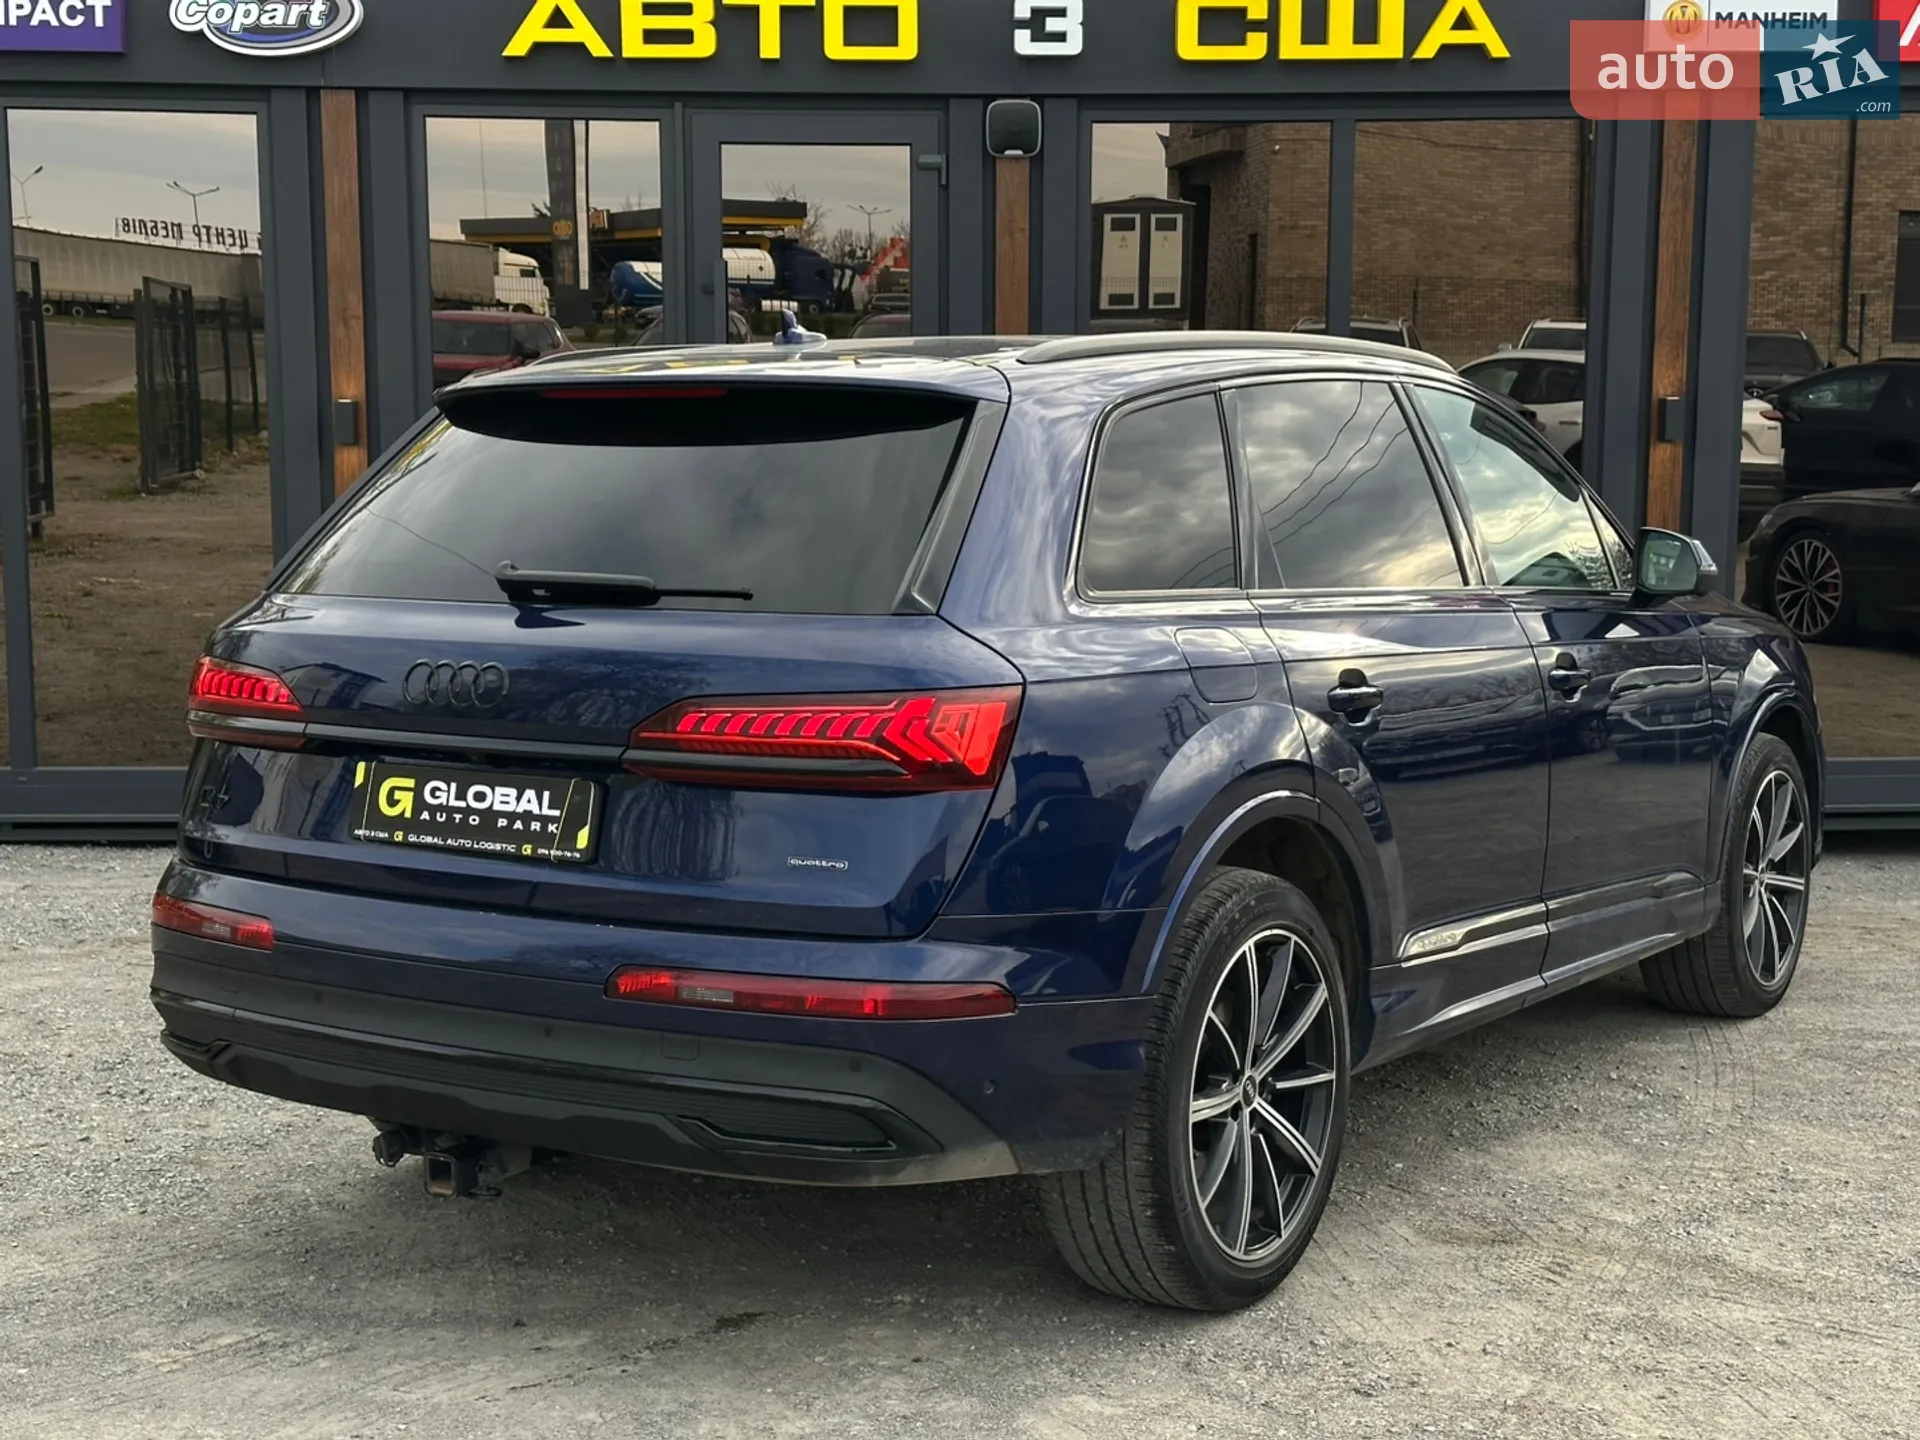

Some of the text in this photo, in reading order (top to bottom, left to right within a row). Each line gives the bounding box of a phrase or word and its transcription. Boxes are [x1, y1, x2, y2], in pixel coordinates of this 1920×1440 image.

[0, 0, 112, 27] PACT
[176, 0, 328, 33] Copart
[1714, 11, 1828, 29] MANHEIM
[501, 0, 919, 61] АВТО
[1175, 0, 1511, 61] США
[423, 780, 561, 816] GLOBAL
[420, 810, 559, 834] AUTO PARK
[407, 834, 516, 852] GLOBAL AUTO LOGISTIC
[790, 858, 844, 868] quattro
